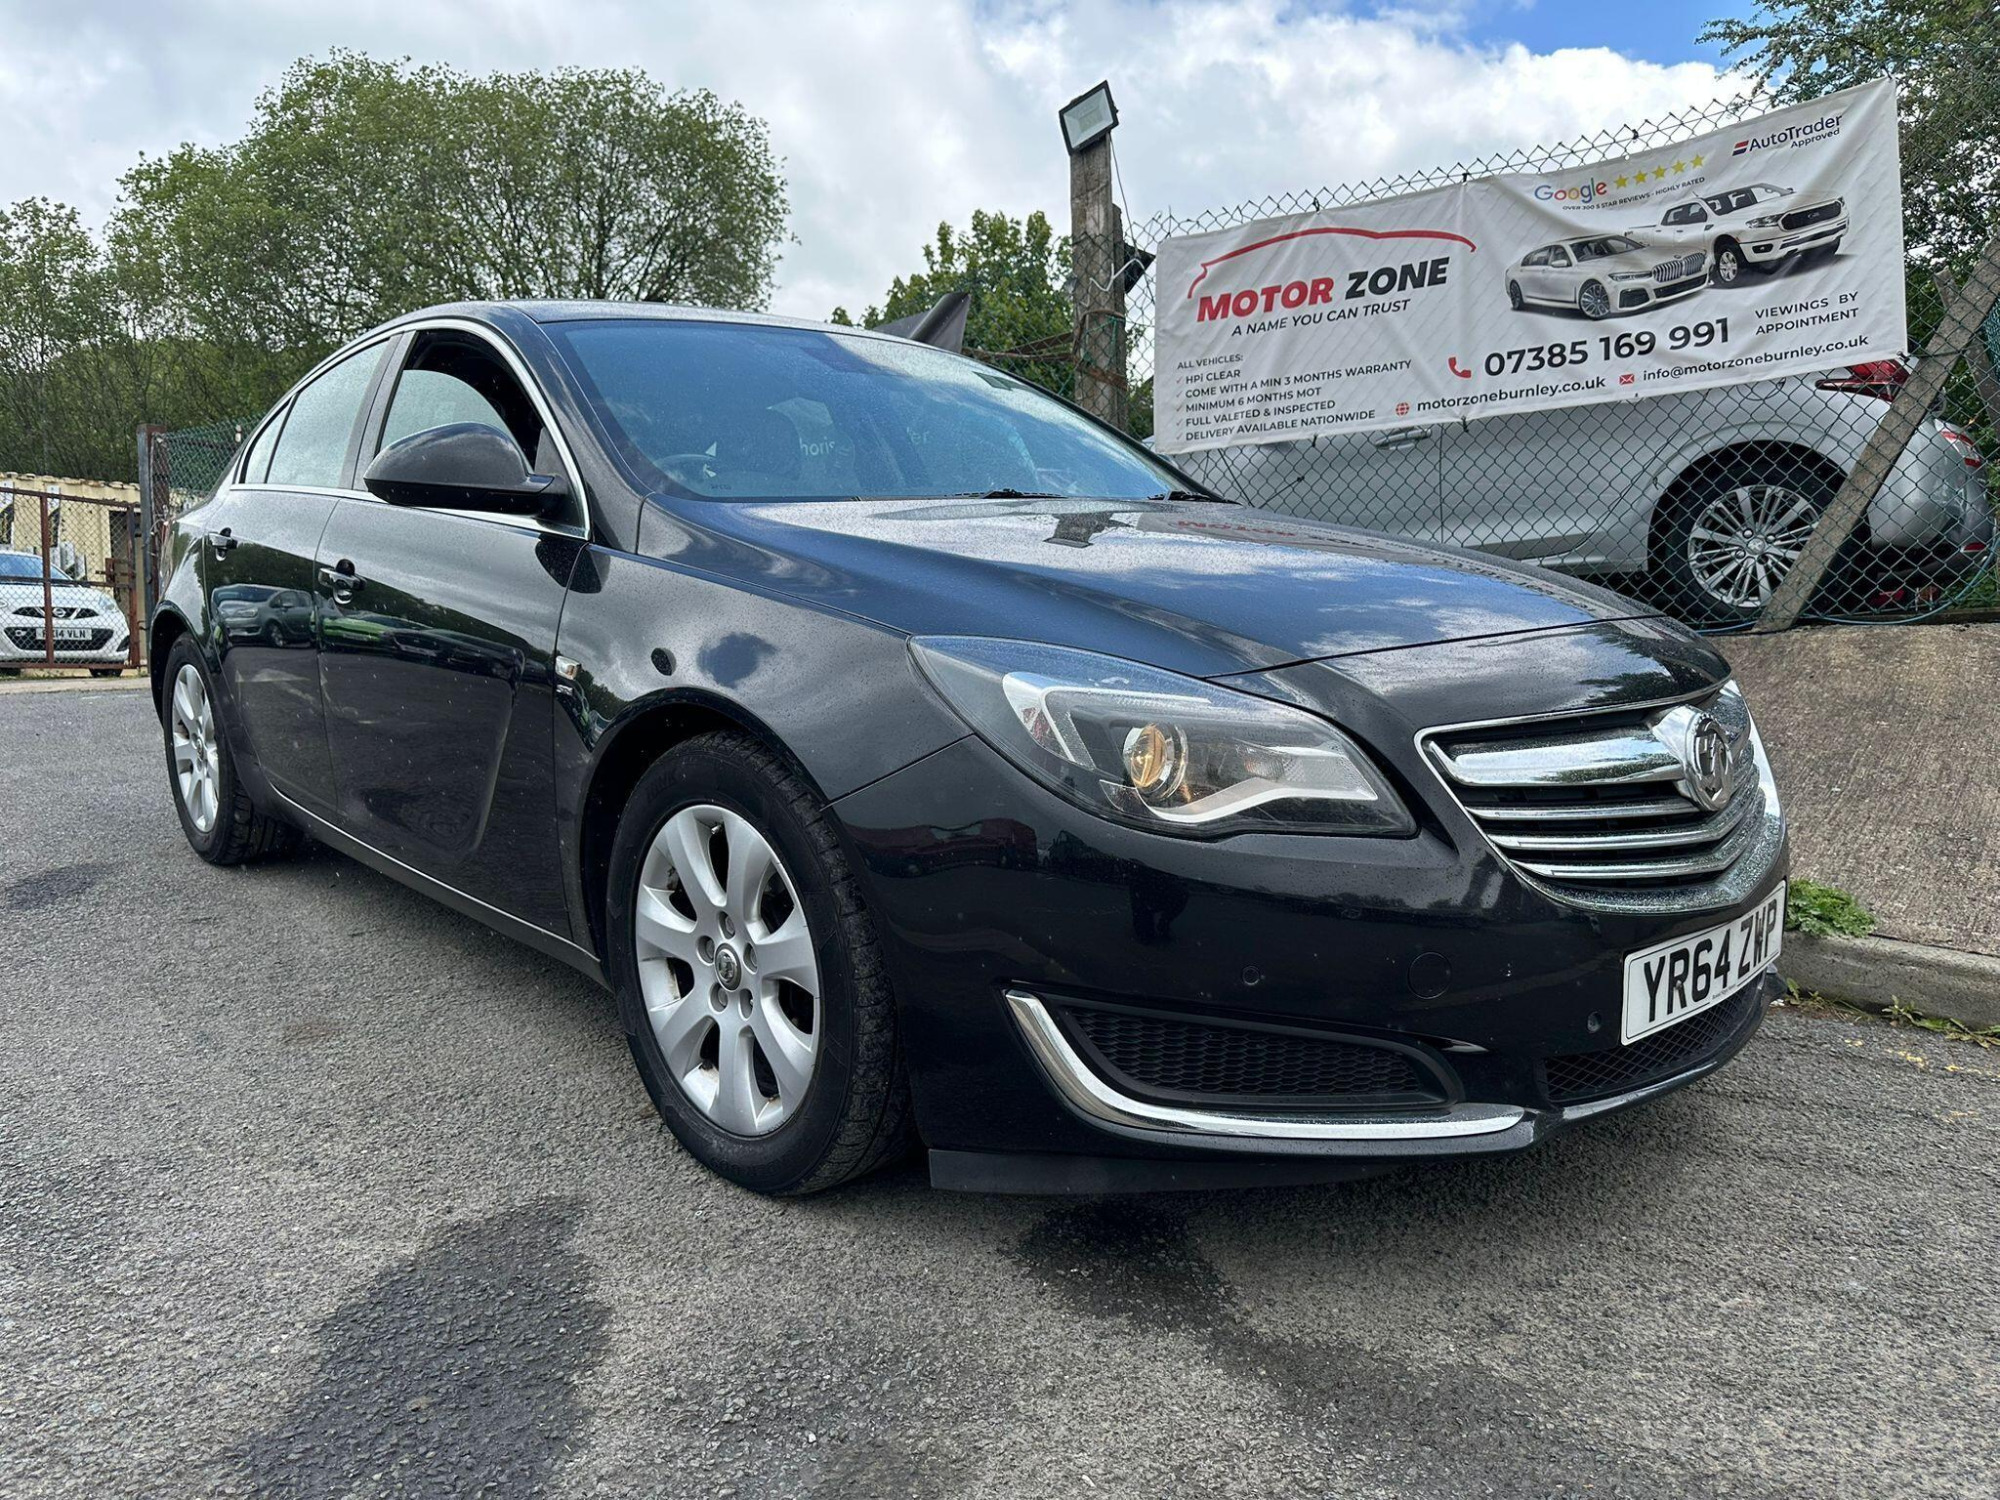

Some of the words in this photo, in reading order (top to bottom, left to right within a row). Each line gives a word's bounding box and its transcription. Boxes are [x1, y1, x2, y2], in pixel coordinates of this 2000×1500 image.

[1750, 115, 1842, 151] AutoTrader
[1791, 128, 1840, 148] Approved
[1534, 177, 1607, 203] Google
[1601, 200, 1618, 208] STAR
[1618, 192, 1650, 205] REVIEWS
[1655, 183, 1680, 196] HIGHLY
[1681, 176, 1705, 188] RATED
[1197, 277, 1334, 322] MOTOR
[1345, 257, 1450, 300] ZONE
[1755, 298, 1829, 319] VIEWINGS
[1839, 291, 1859, 304] BY
[1231, 325, 1242, 337] A
[1246, 317, 1287, 334] NAME
[1292, 311, 1323, 327] YOU
[1327, 306, 1358, 322] CAN
[1363, 299, 1411, 317] TRUST
[1755, 307, 1860, 335] APPOINTMENT
[1177, 361, 1194, 369] ALL
[1196, 353, 1244, 366] VEHICLES:
[1484, 340, 1588, 376] 07385
[1599, 331, 1656, 361] 169
[1669, 317, 1728, 350] 991
[1185, 387, 1216, 398] COME
[1219, 382, 1248, 394] WITH
[1250, 381, 1258, 390] A
[1260, 378, 1281, 388] MIN
[1284, 376, 1291, 385] 3
[1293, 369, 1342, 384] MONTHS
[1345, 359, 1412, 377] WARRANTY
[1206, 369, 1241, 381] CLEAR
[1417, 376, 1606, 411] motorzoneburnley.co.uk
[1643, 334, 1869, 381] info@motorzoneburnley.co.uk
[1186, 398, 1235, 412] MINIMUM
[1238, 397, 1244, 406] 6
[1247, 390, 1294, 404] MONTHS
[1297, 387, 1322, 399] MOT
[1186, 416, 1211, 427] FULL
[1214, 409, 1260, 423] VALETED
[1263, 407, 1271, 417] &
[1274, 400, 1336, 415] INSPECTED
[1185, 426, 1235, 441] DELIVERY
[1236, 420, 1298, 433] AVAILABLE
[1301, 409, 1375, 427] NATIONWIDE
[1644, 929, 1731, 1023] YR64
[1738, 899, 1778, 980] ZWP
